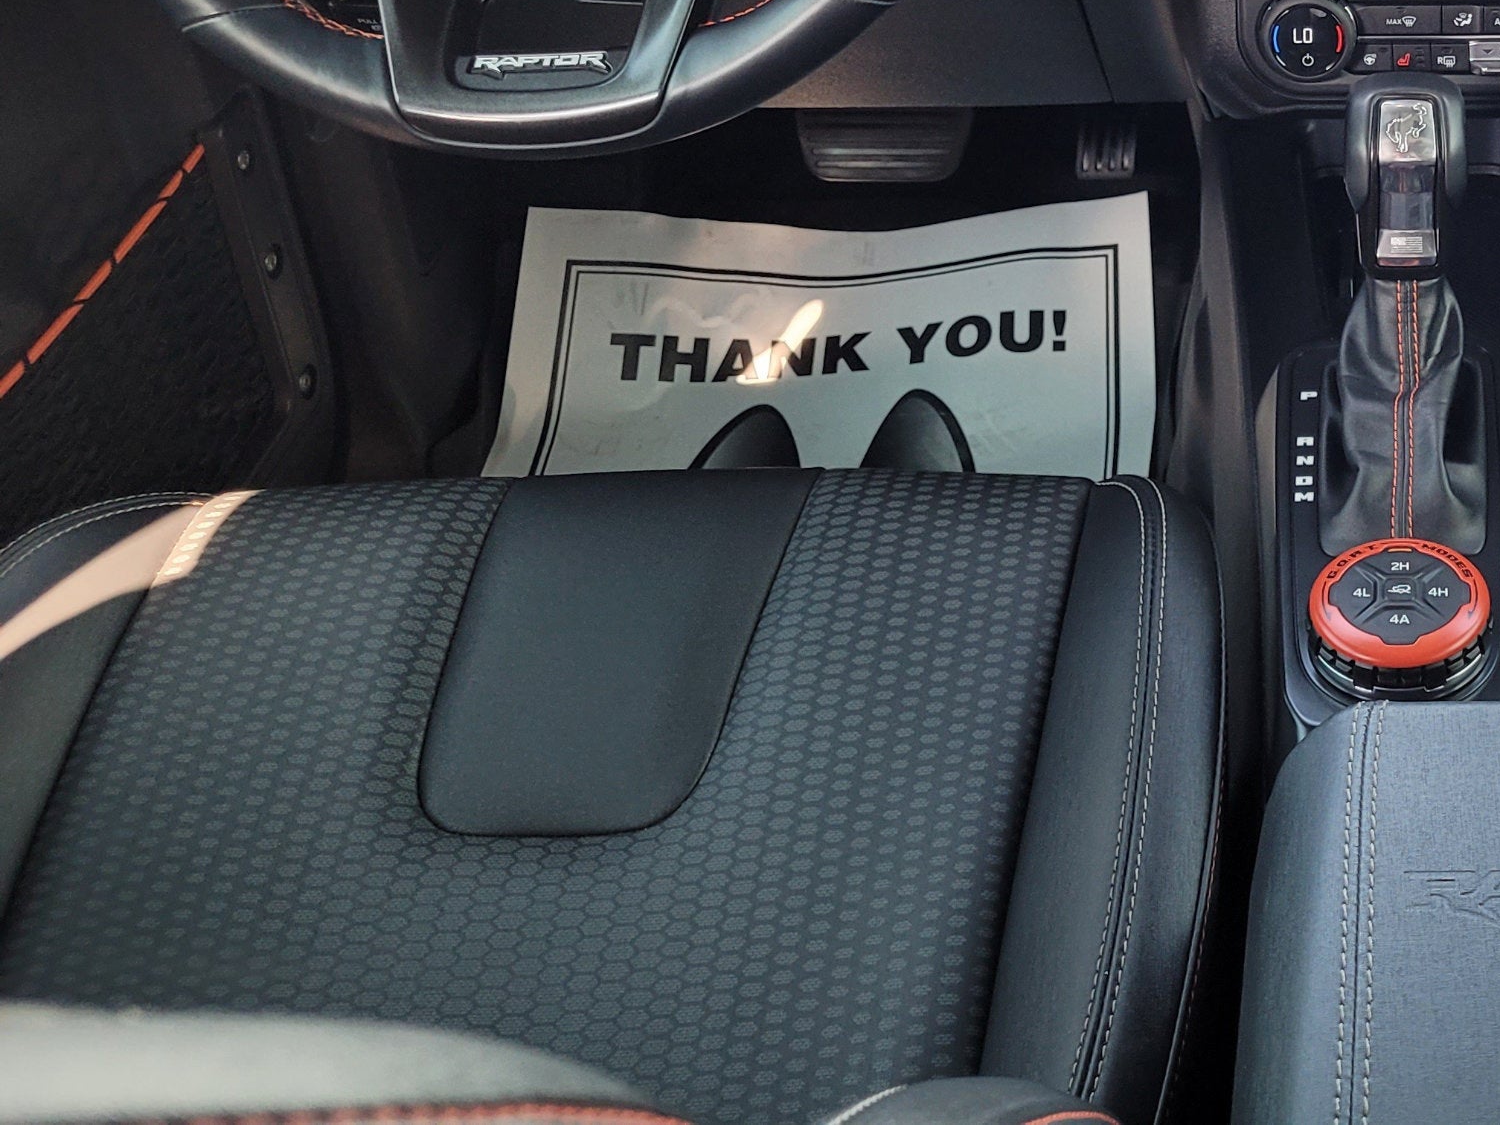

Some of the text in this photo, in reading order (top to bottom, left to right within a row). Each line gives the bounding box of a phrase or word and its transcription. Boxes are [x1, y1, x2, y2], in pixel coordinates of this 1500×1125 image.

[473, 52, 608, 74] RAPTOR
[610, 309, 1067, 383] THANK YOU!
[1421, 543, 1475, 579] MODES
[1391, 562, 1410, 571] 2H
[1352, 587, 1371, 597] 4L
[1428, 587, 1449, 597] 4H
[1389, 615, 1410, 624] 4A
